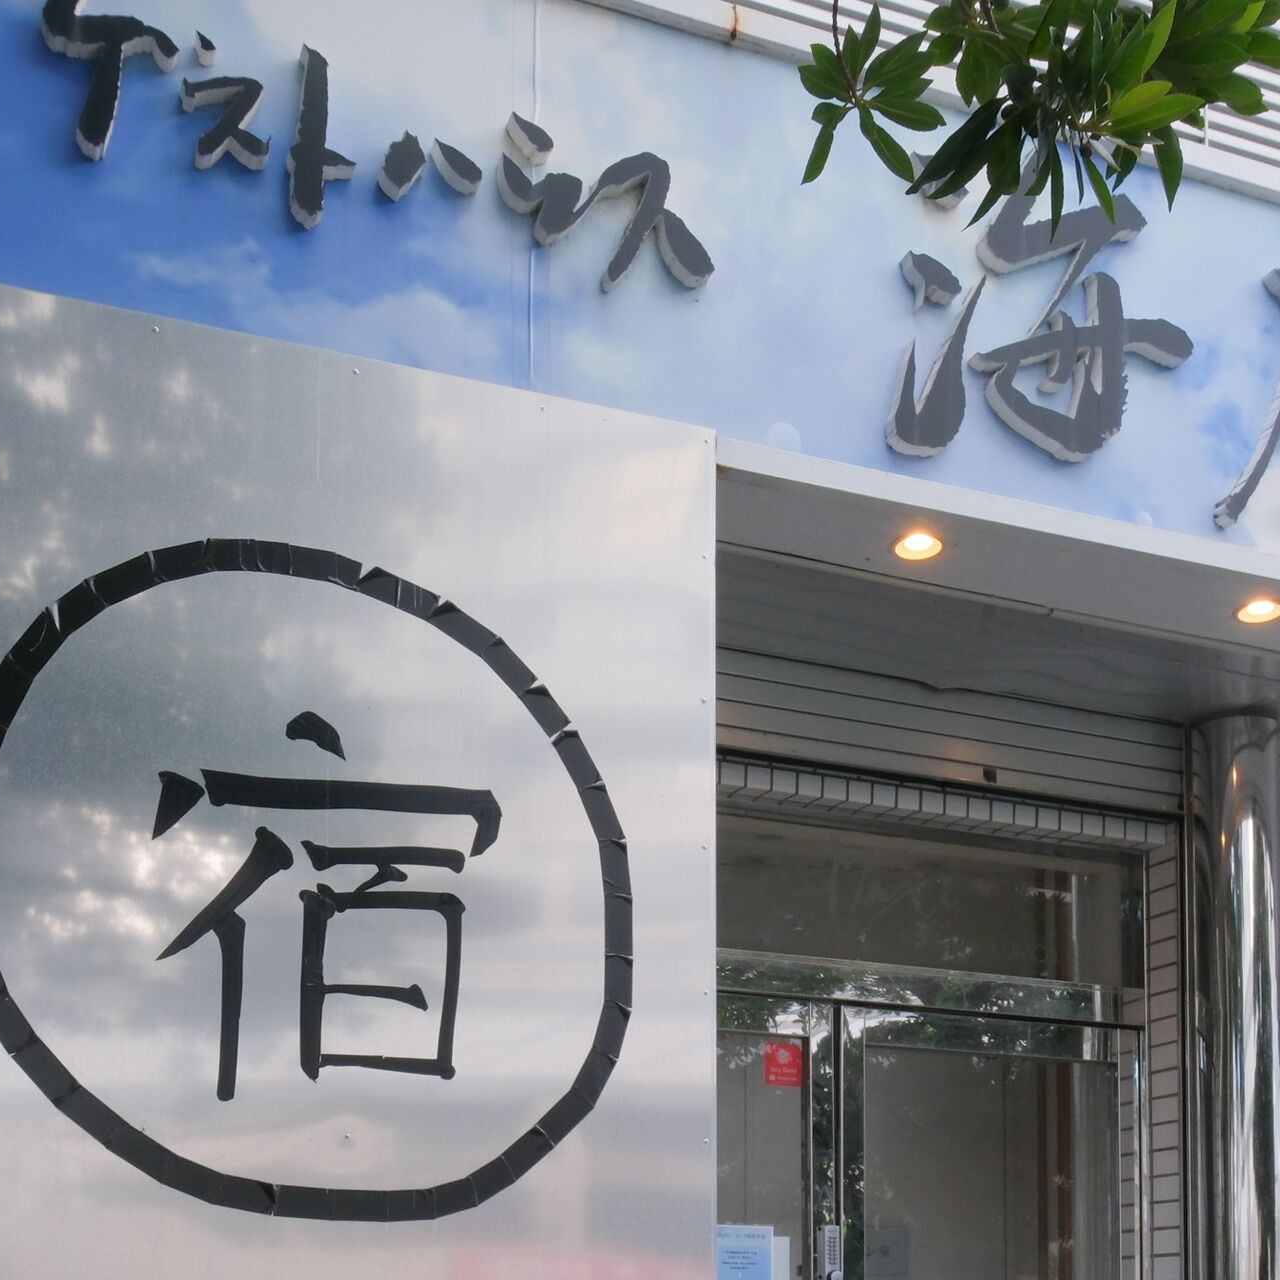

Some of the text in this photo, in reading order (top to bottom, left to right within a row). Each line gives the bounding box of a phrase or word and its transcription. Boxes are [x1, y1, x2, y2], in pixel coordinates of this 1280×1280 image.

[41, 0, 715, 294] ゲストハウス
[151, 709, 503, 1102] 宿
